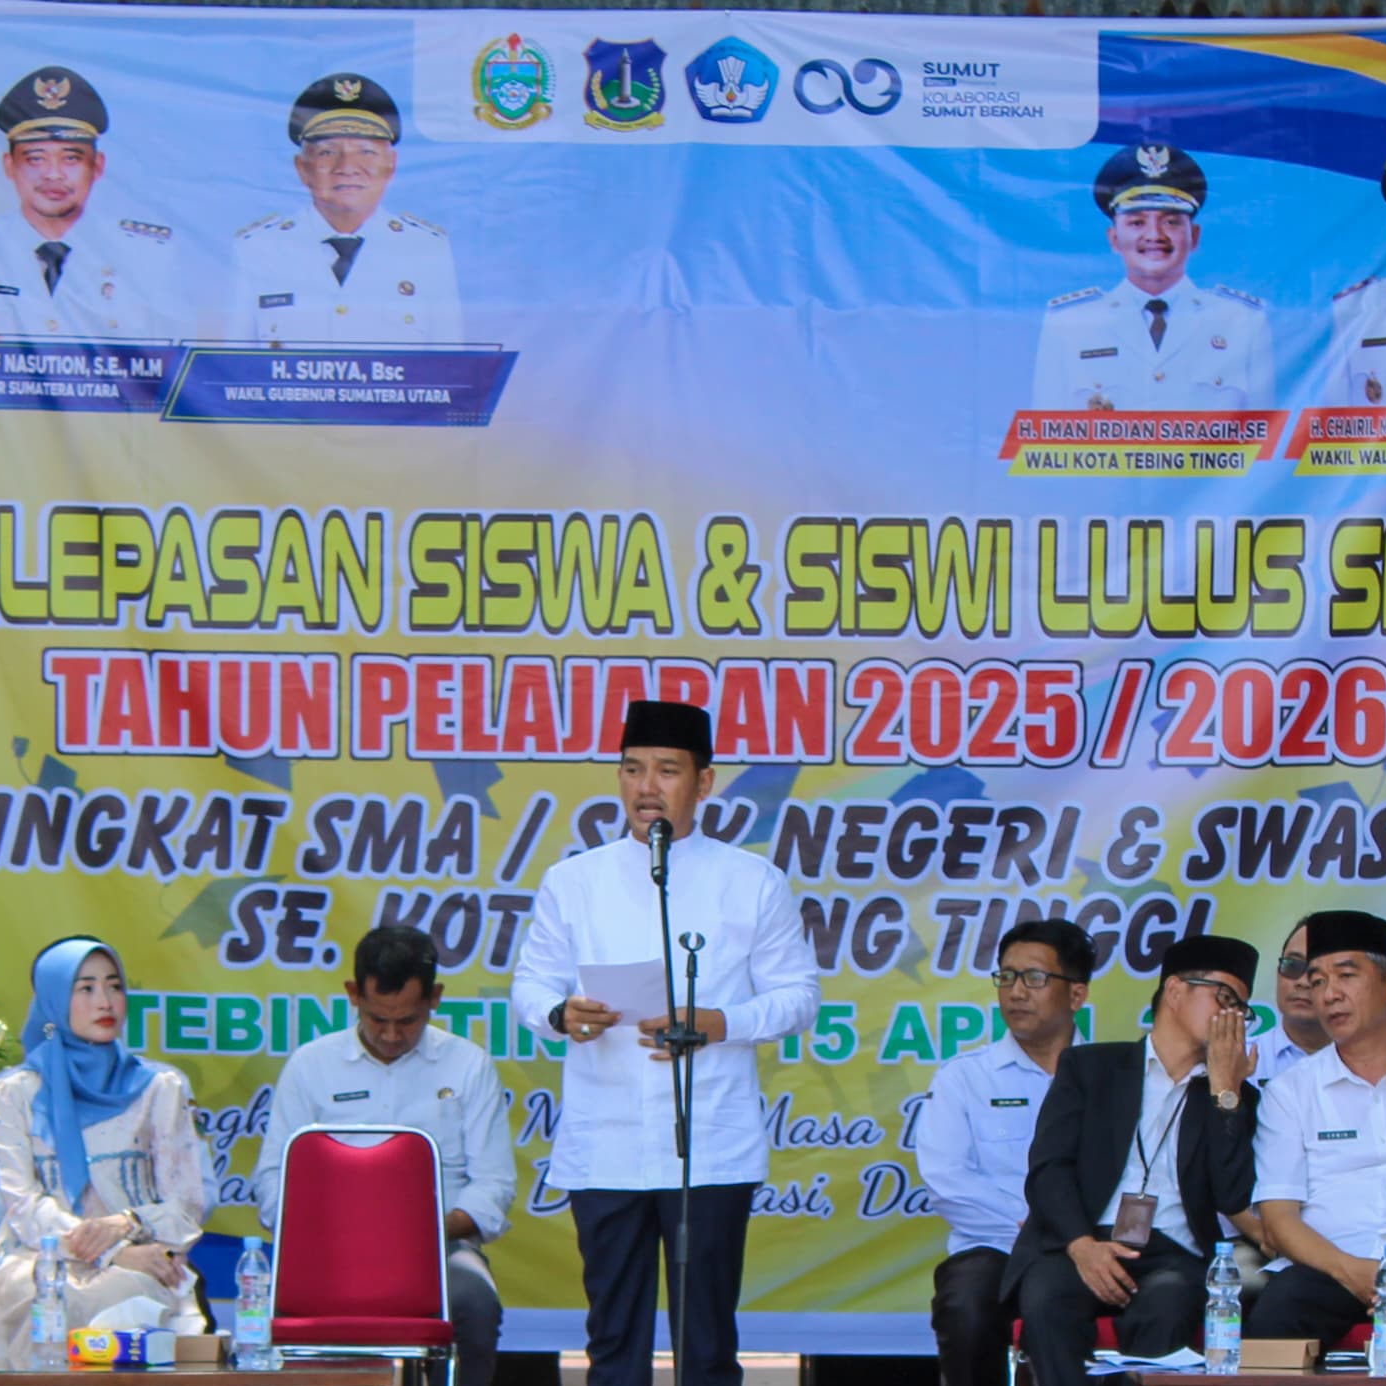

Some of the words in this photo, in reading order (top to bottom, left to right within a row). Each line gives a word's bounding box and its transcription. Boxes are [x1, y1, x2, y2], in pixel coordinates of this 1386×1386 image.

[923, 61, 1001, 78] SUMUT
[923, 91, 1020, 104] KOLABORASI
[922, 105, 976, 118] SUMUT
[979, 106, 1044, 118] BERKAH
[4, 355, 91, 378] NASUTION,
[130, 357, 163, 378] M.M
[271, 360, 293, 380] H.
[296, 361, 367, 384] SURYA,
[371, 362, 405, 381] Bsc
[8, 381, 75, 397] SUMATERA
[77, 382, 120, 398] UTARA
[225, 386, 266, 401] WAKIL
[268, 387, 336, 402] GUBERNUR
[338, 388, 406, 403] SUMATERA
[408, 389, 451, 404] UTARA
[1018, 420, 1038, 439] H.
[1042, 420, 1089, 440] IMAN
[1094, 420, 1155, 440] IRDIAN
[1160, 420, 1268, 443] SARAGIH,SE
[1326, 415, 1376, 438] CHAIRIL
[1025, 451, 1068, 470] WALI
[1073, 451, 1120, 470] KOTA
[1125, 451, 1185, 470] TEBING
[1190, 450, 1245, 470] TINGGI
[1310, 449, 1355, 466] WAKIL
[410, 511, 675, 635] SISWA
[698, 516, 762, 636] &
[783, 515, 1010, 638] SISWI
[1037, 518, 1306, 638] LULUS
[48, 654, 335, 755] TAHUN
[847, 664, 1084, 761] 2025
[1099, 664, 1145, 761] /
[303, 797, 478, 879] SMA
[500, 798, 553, 882] /
[774, 804, 1081, 887] NEGERI
[1107, 804, 1162, 880] &
[226, 889, 338, 964] SE.
[127, 994, 348, 1052] TEBIN
